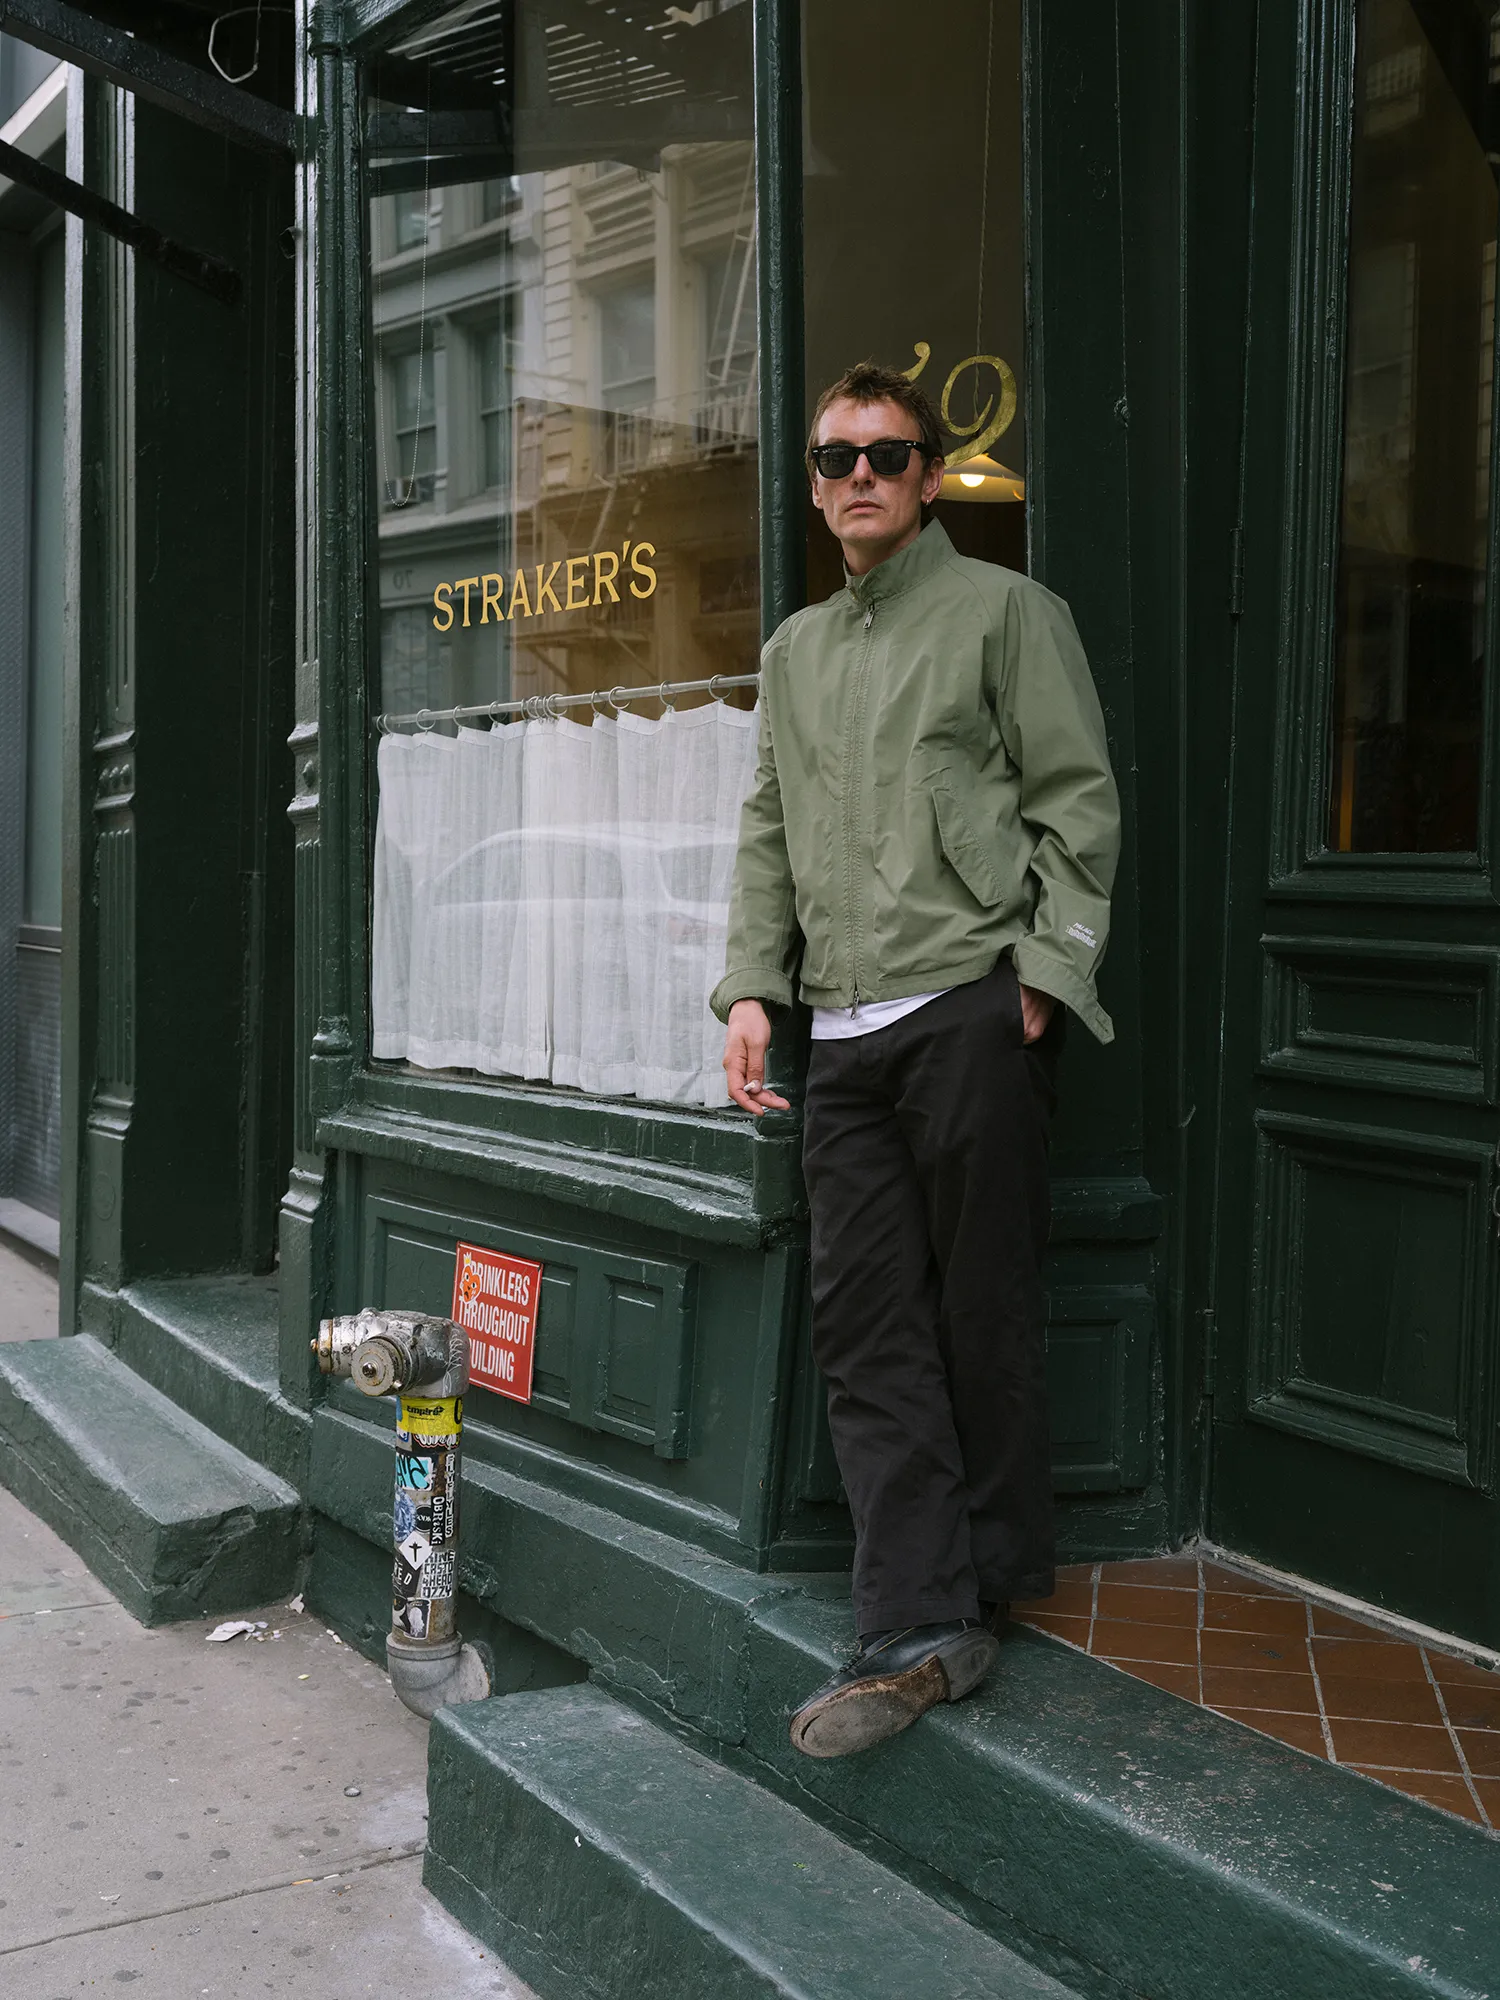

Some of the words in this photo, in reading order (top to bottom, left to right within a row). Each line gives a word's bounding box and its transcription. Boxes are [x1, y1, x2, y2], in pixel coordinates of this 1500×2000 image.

[433, 540, 657, 632] STRAKER'S
[470, 1260, 530, 1306] RINKLERS
[459, 1295, 530, 1346] THROUGHOUT
[469, 1337, 515, 1382] UILDING
